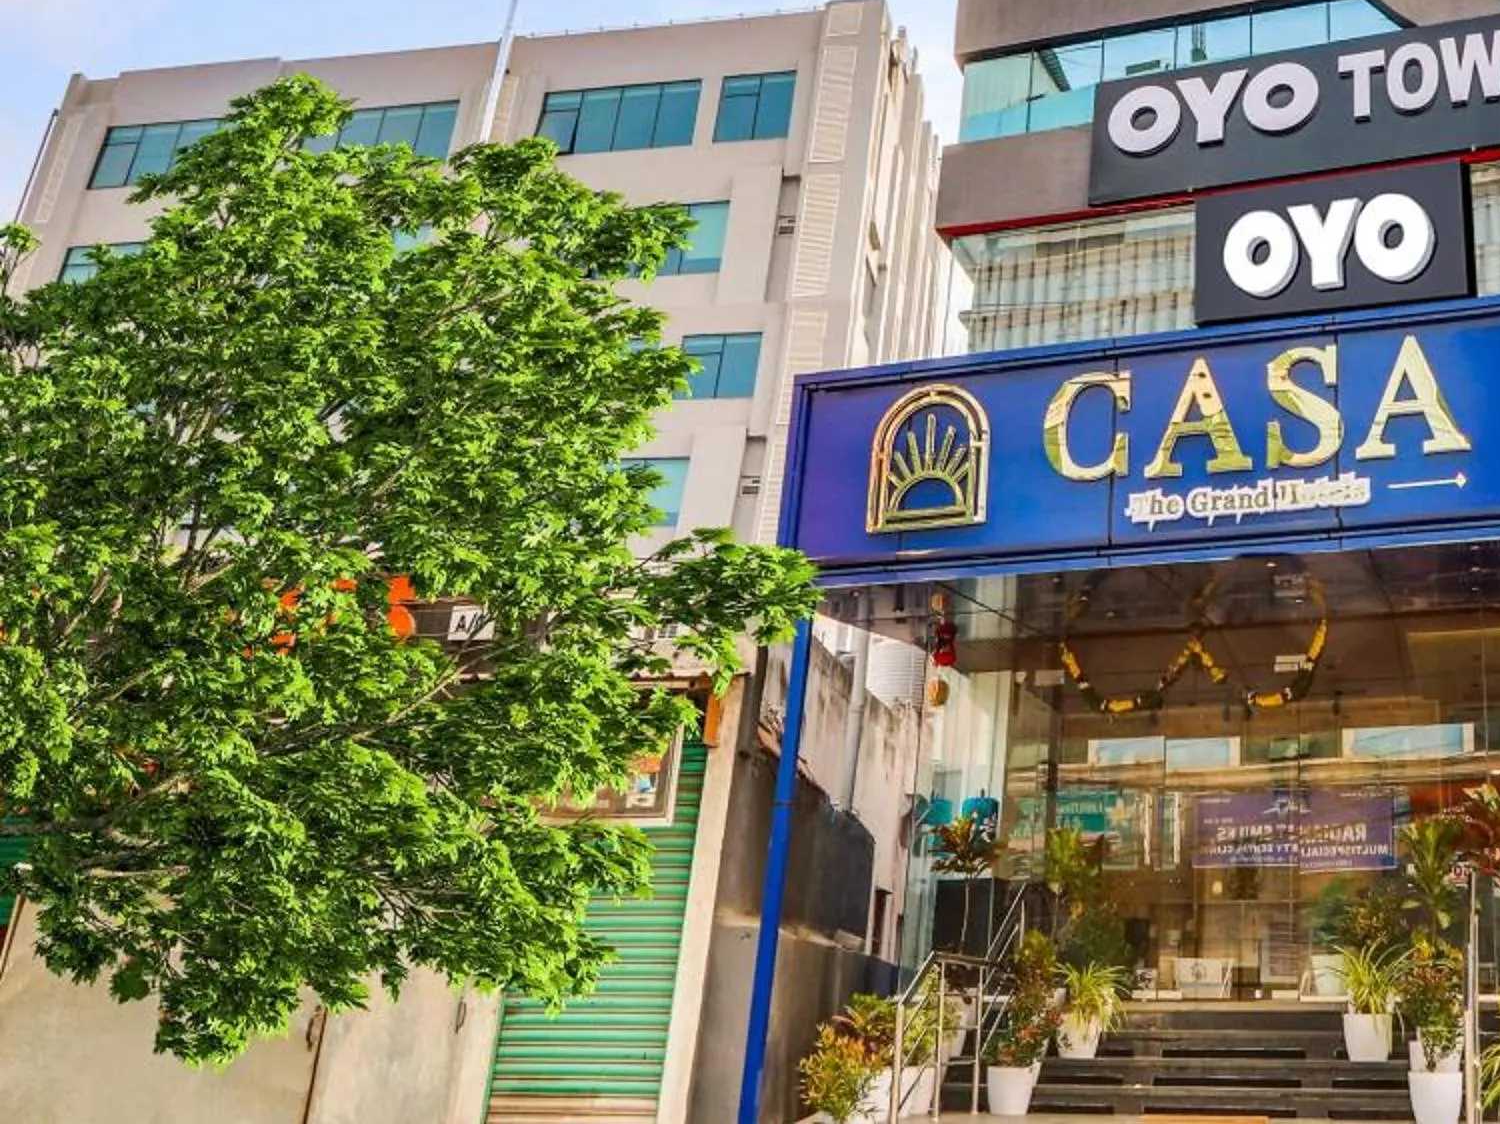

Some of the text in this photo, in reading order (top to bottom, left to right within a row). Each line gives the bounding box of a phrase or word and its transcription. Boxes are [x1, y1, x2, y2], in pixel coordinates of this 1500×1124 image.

[1107, 62, 1320, 155] OYO
[1222, 193, 1438, 297] OYO
[1042, 335, 1473, 482] CASA
[1188, 483, 1271, 515] Grand
